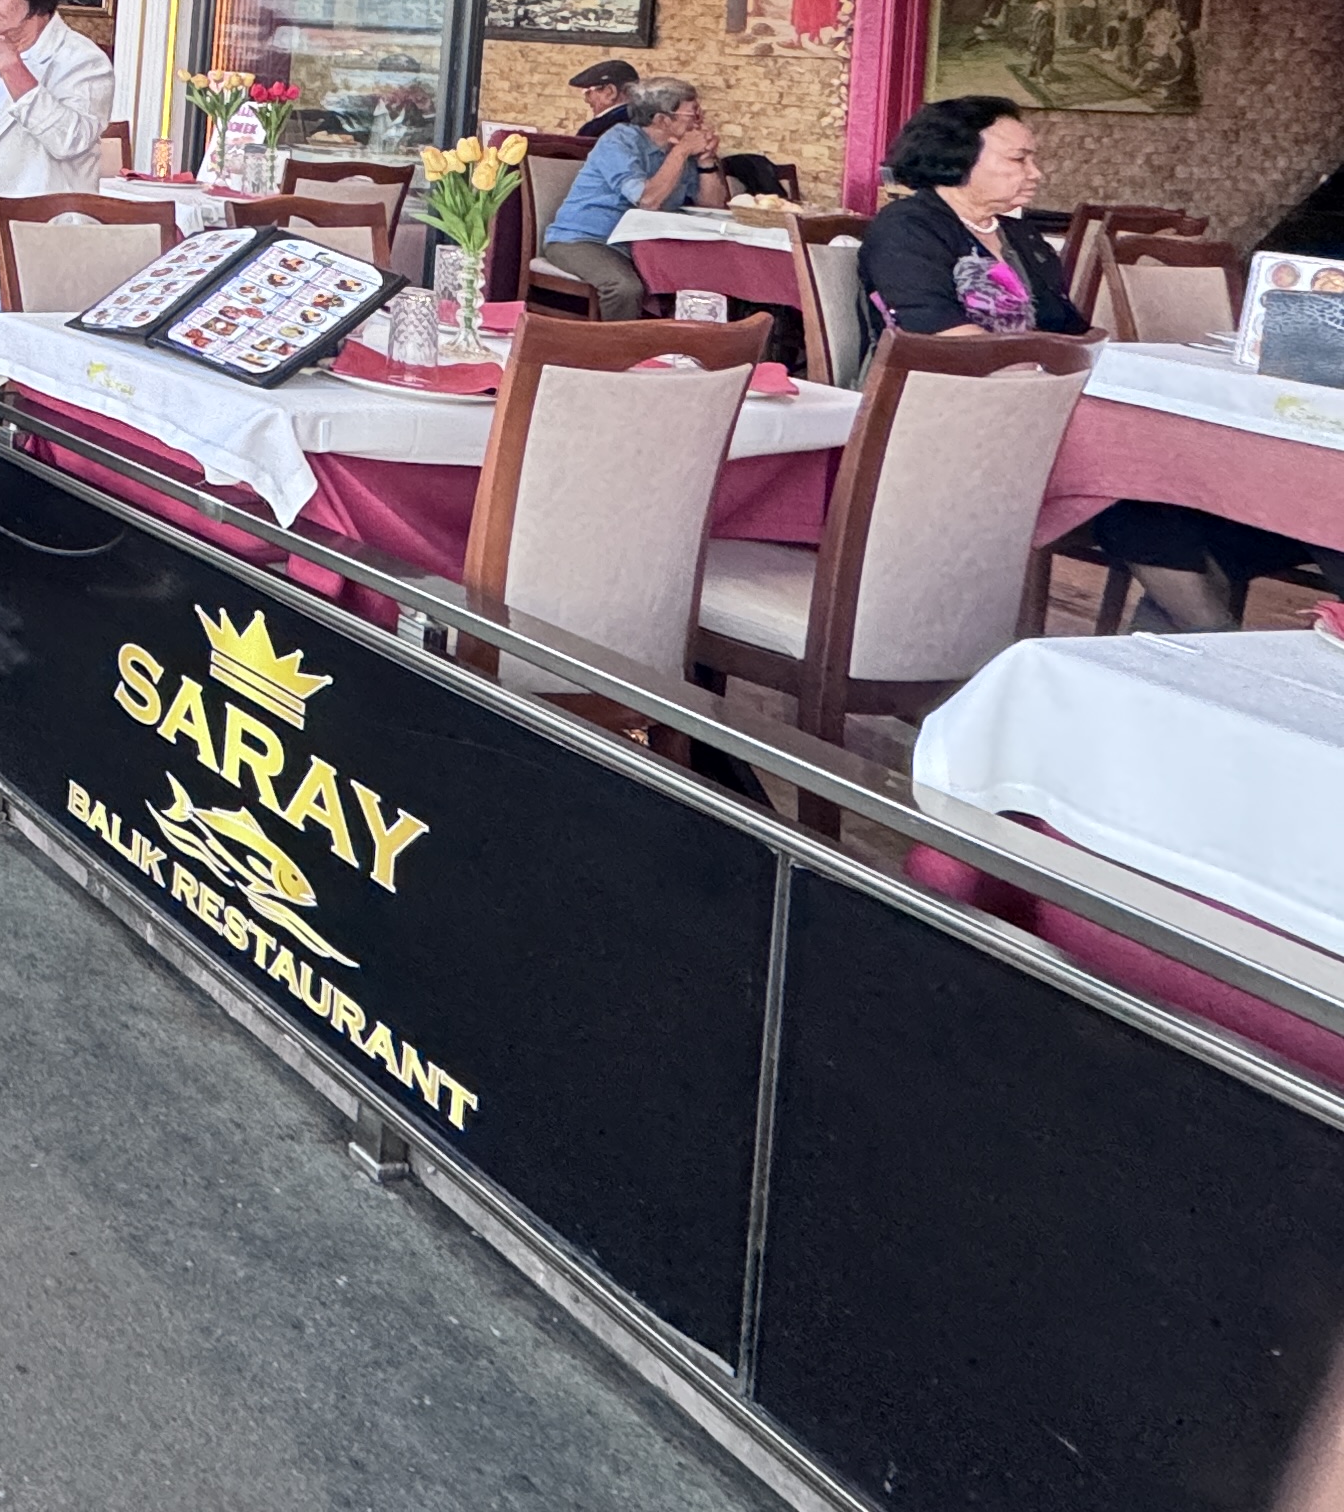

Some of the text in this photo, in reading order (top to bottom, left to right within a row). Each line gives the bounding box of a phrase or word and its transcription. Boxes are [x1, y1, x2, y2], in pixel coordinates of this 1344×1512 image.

[113, 642, 430, 894] SARAY
[68, 779, 479, 1131] BALIK RESTAURANT
